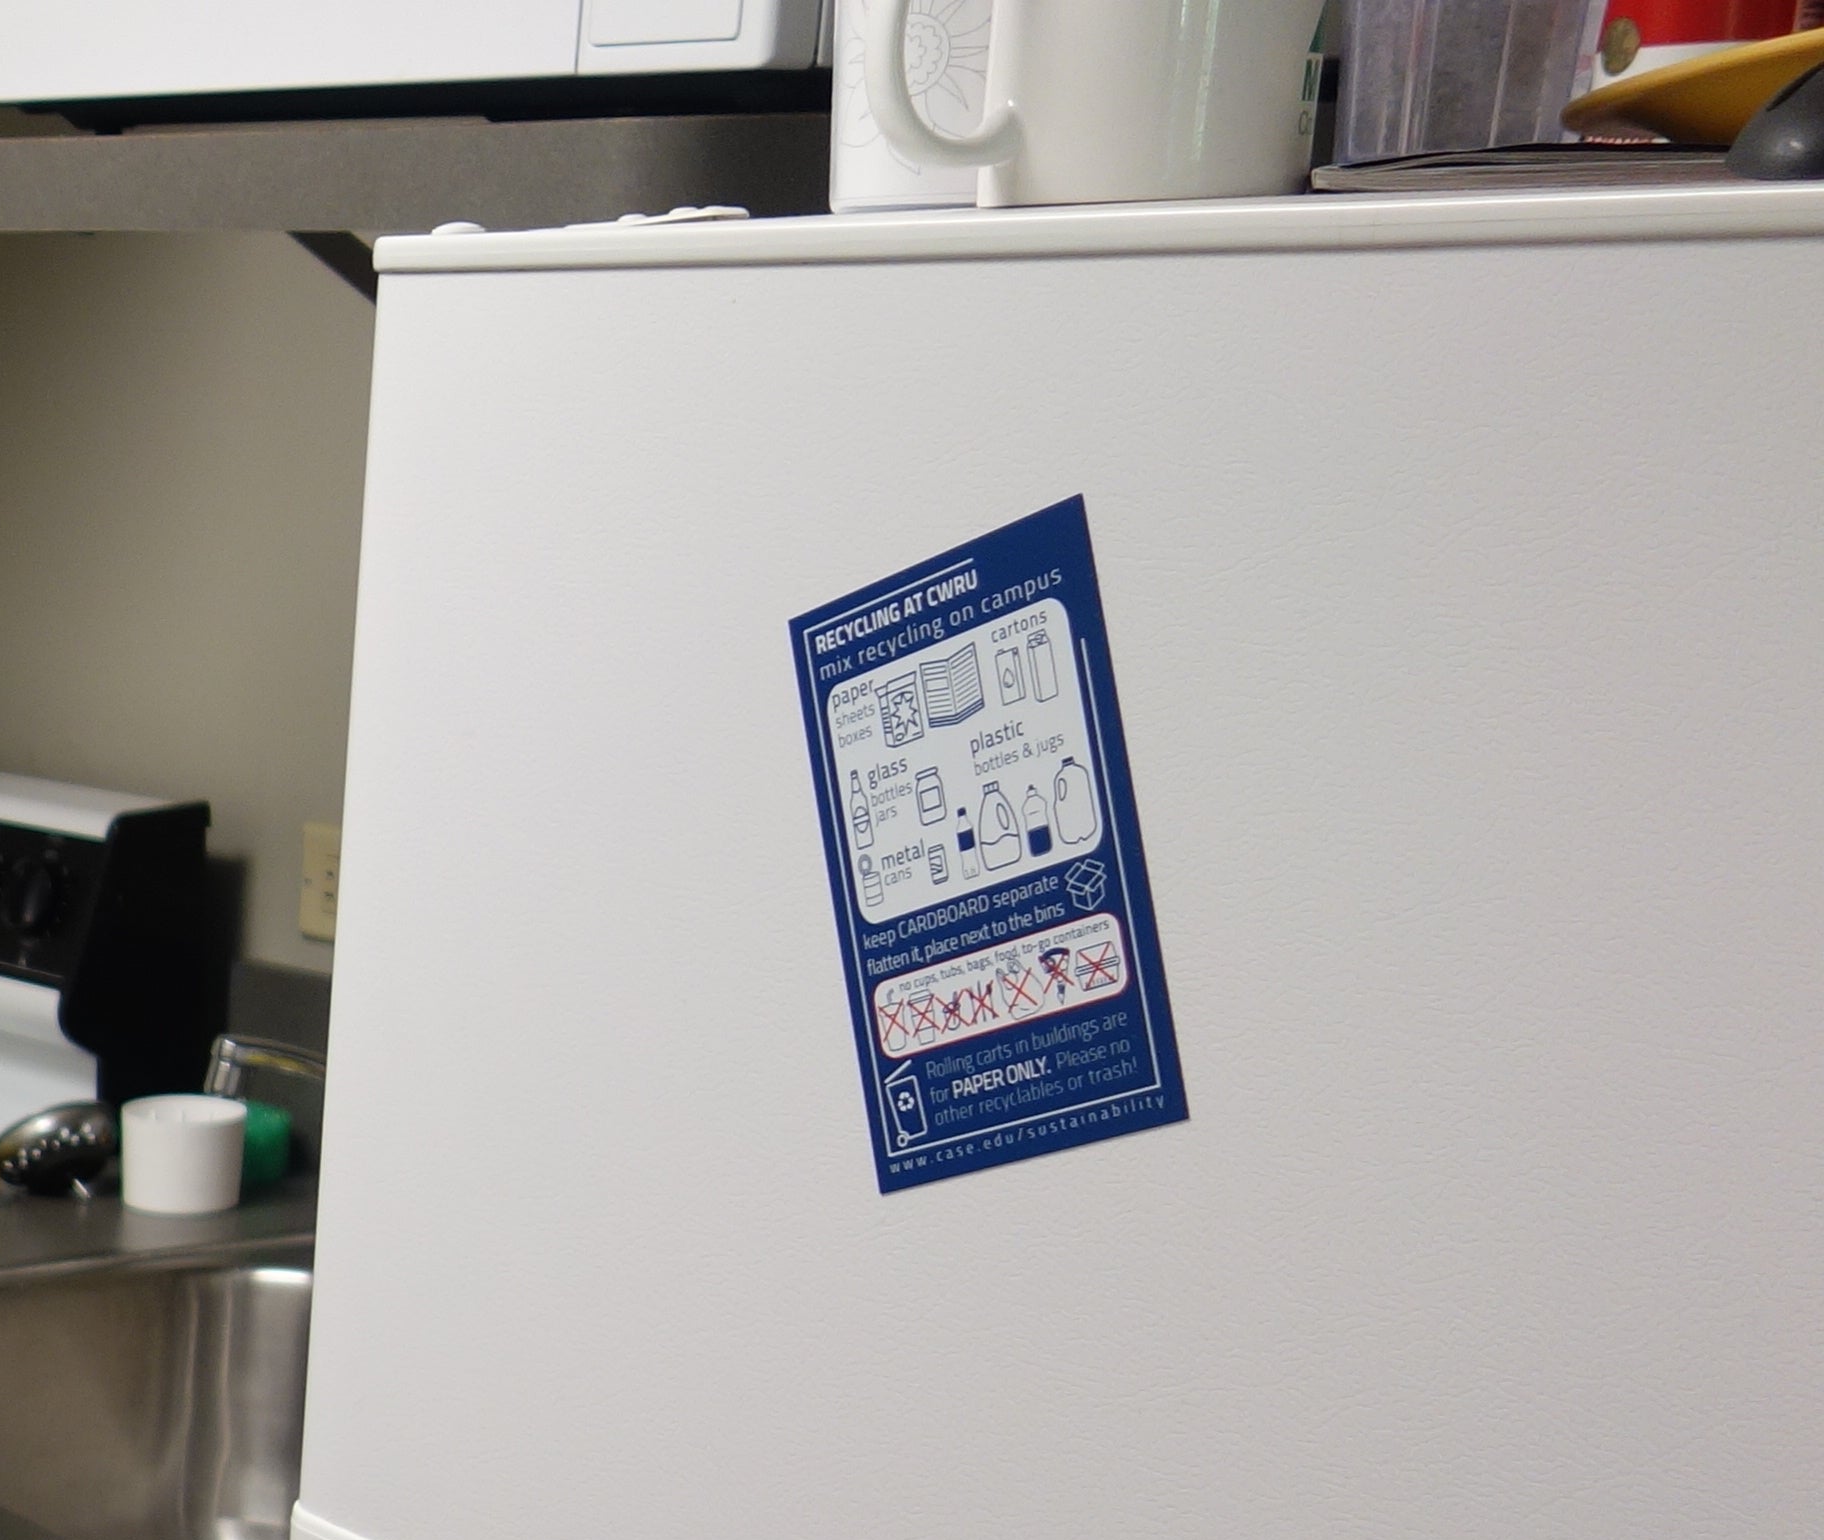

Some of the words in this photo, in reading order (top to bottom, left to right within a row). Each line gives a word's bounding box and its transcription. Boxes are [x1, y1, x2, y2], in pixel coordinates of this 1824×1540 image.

[815, 602, 900, 654] RECYCLING
[903, 592, 924, 618] AT
[926, 569, 978, 608] CWRU
[819, 658, 853, 681] mix
[858, 616, 945, 664] recycling
[949, 605, 974, 627] on
[981, 567, 1062, 613] campus
[991, 610, 1047, 643] cartons
[831, 679, 874, 712] paper
[835, 703, 875, 729] sheets
[838, 727, 872, 748] boxes
[970, 720, 1024, 758] plastic
[974, 748, 1019, 776] bottles
[1022, 742, 1033, 758] &
[1036, 733, 1064, 757] jugs
[868, 758, 908, 789] glass
[870, 781, 913, 807] bottles
[875, 805, 898, 826] jars
[881, 838, 925, 870] metal
[884, 867, 912, 886] cans
[863, 929, 896, 950] keep
[898, 895, 990, 938] CARDBOARD
[993, 876, 1058, 909] separate
[866, 952, 909, 976] flatten
[911, 947, 924, 963] it,
[925, 937, 959, 964] place
[961, 925, 991, 947] next
[992, 921, 1007, 937] to
[1008, 912, 1032, 932] the
[1033, 902, 1065, 922] bins
[899, 981, 912, 991] no
[1022, 938, 1051, 955] to-go
[1053, 919, 1110, 945] containers
[926, 1055, 975, 1079] Rolling
[976, 1042, 1012, 1066] carts
[1015, 1038, 1029, 1054] in
[1032, 1019, 1099, 1050] buildings
[1102, 1012, 1127, 1031] are
[930, 1086, 950, 1104] for
[952, 1068, 1006, 1099] PAPER
[1006, 1056, 1052, 1084] ONLY.
[1055, 1045, 1107, 1069] Please
[1110, 1039, 1130, 1055] no
[934, 1104, 973, 1126] other
[978, 1080, 1064, 1114] recyclables
[1067, 1075, 1084, 1091] or
[1088, 1056, 1137, 1085] trash!
[889, 1094, 1165, 1174] www.case.edu/sustainability
